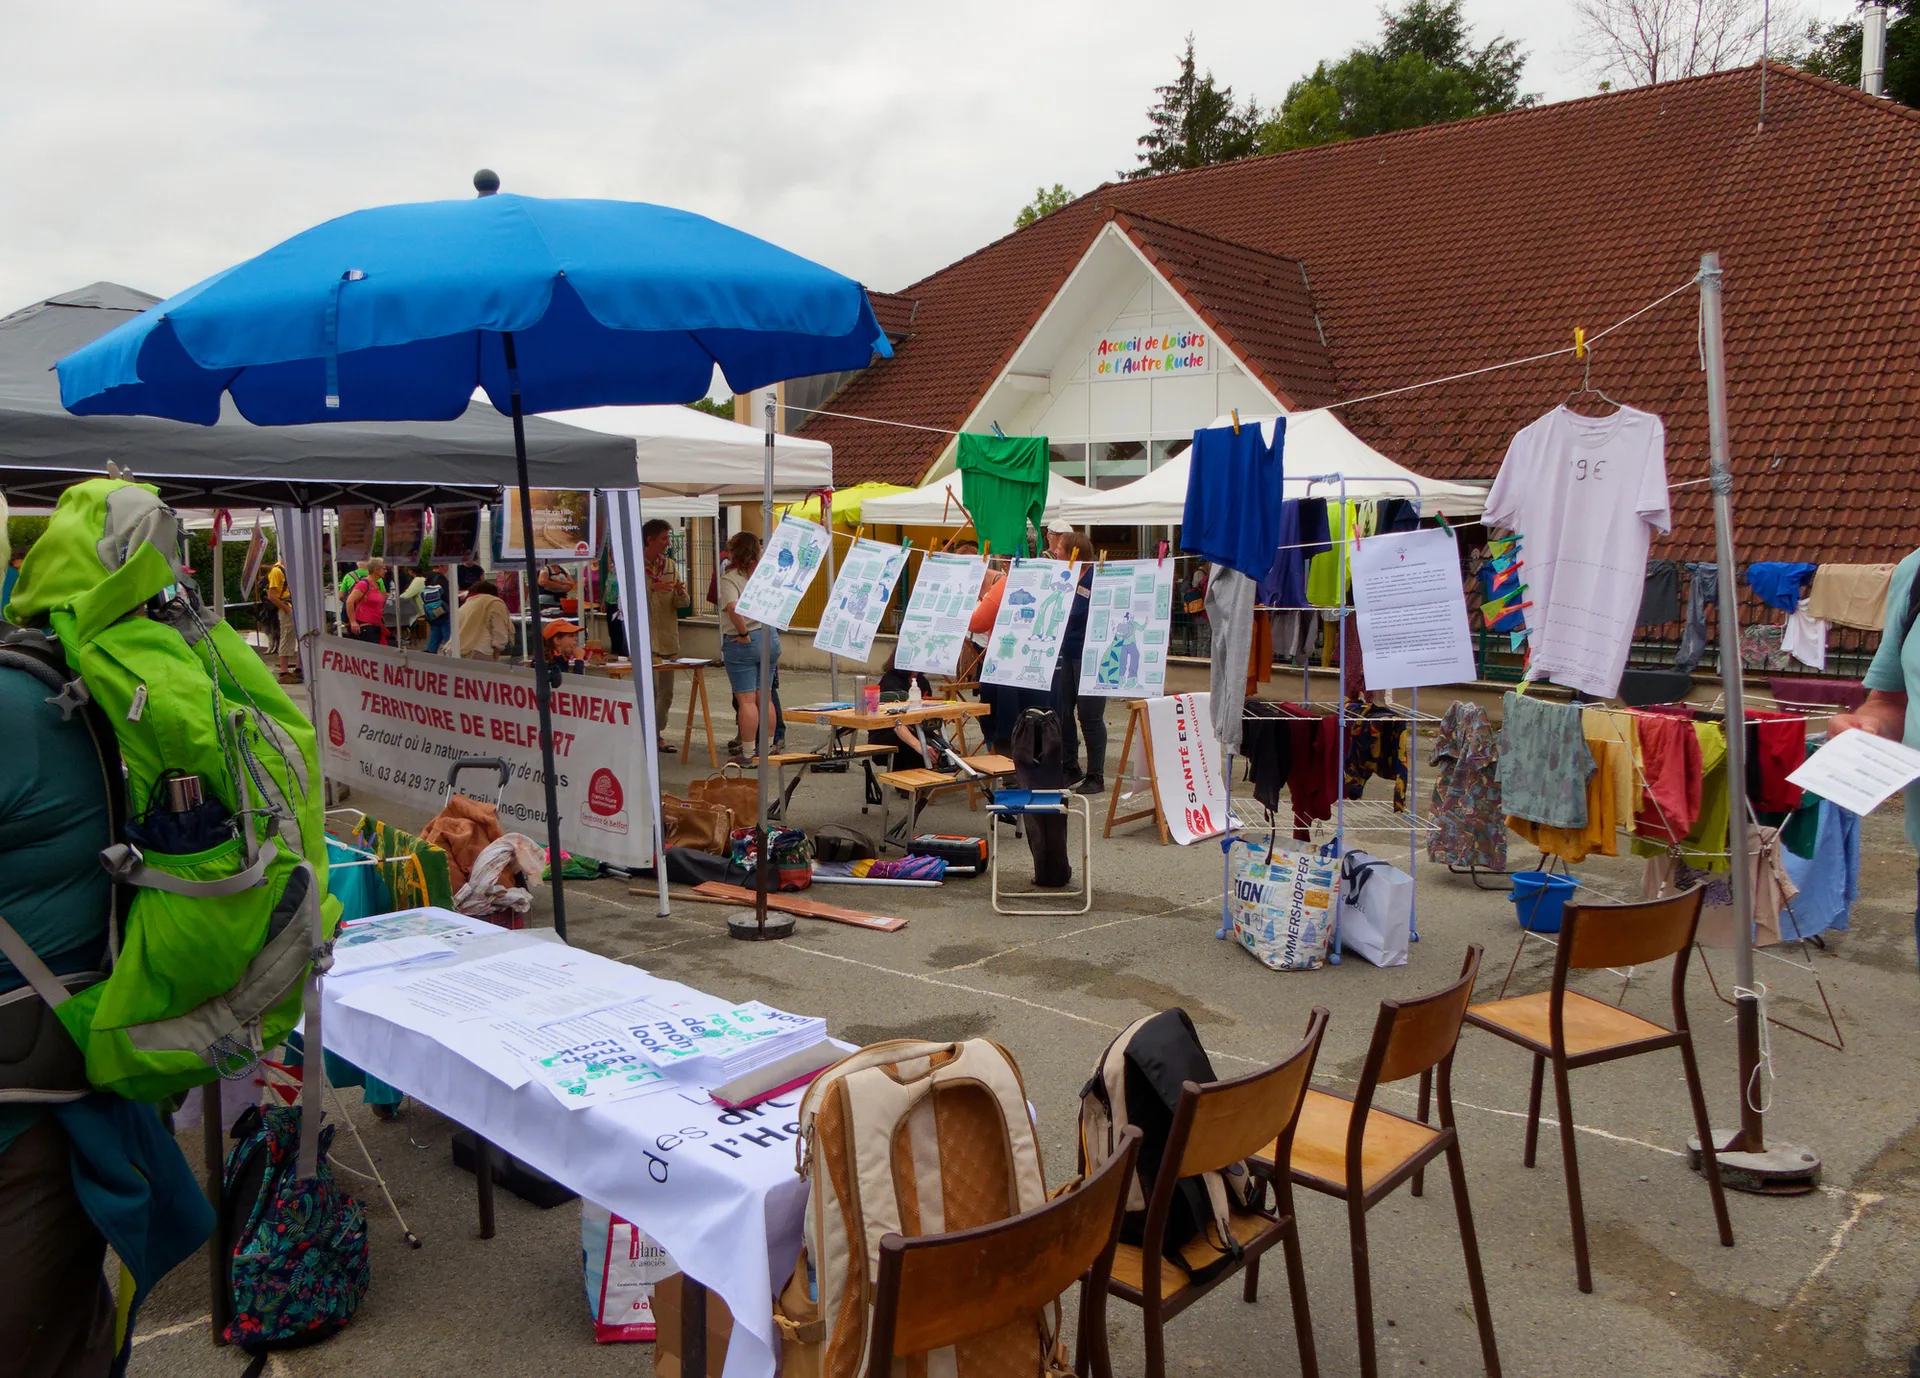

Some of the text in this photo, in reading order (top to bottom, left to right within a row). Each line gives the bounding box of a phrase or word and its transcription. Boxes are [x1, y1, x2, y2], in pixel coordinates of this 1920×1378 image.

[1097, 331, 1205, 355] Accueil de Loisirs
[1097, 352, 1204, 374] de l'Autre Ruche
[322, 650, 379, 682] FRANCE
[383, 663, 448, 696] NATURE
[361, 690, 456, 732] TERRITOIRE
[460, 713, 485, 738] DE
[1177, 719, 1187, 742] EN
[358, 724, 403, 747] Partout
[404, 735, 419, 751] où
[421, 737, 432, 754] la
[517, 762, 531, 780] de
[360, 760, 375, 778] Tél.
[378, 766, 391, 781] 03
[393, 770, 407, 785] 84
[408, 773, 421, 788] 29
[423, 777, 436, 792] 37
[1178, 746, 1197, 803] SANTÉ
[1280, 856, 1310, 970] SUMMERSHOPPER
[681, 1017, 708, 1039] de
[731, 1008, 755, 1024] Le
[628, 1024, 666, 1053] look
[655, 1020, 695, 1049] mon
[557, 1039, 619, 1056] look
[562, 1047, 627, 1063] mon
[599, 1055, 637, 1065] de
[625, 1071, 663, 1082] Le
[642, 1126, 708, 1183] des
[633, 1241, 666, 1258] Hans
